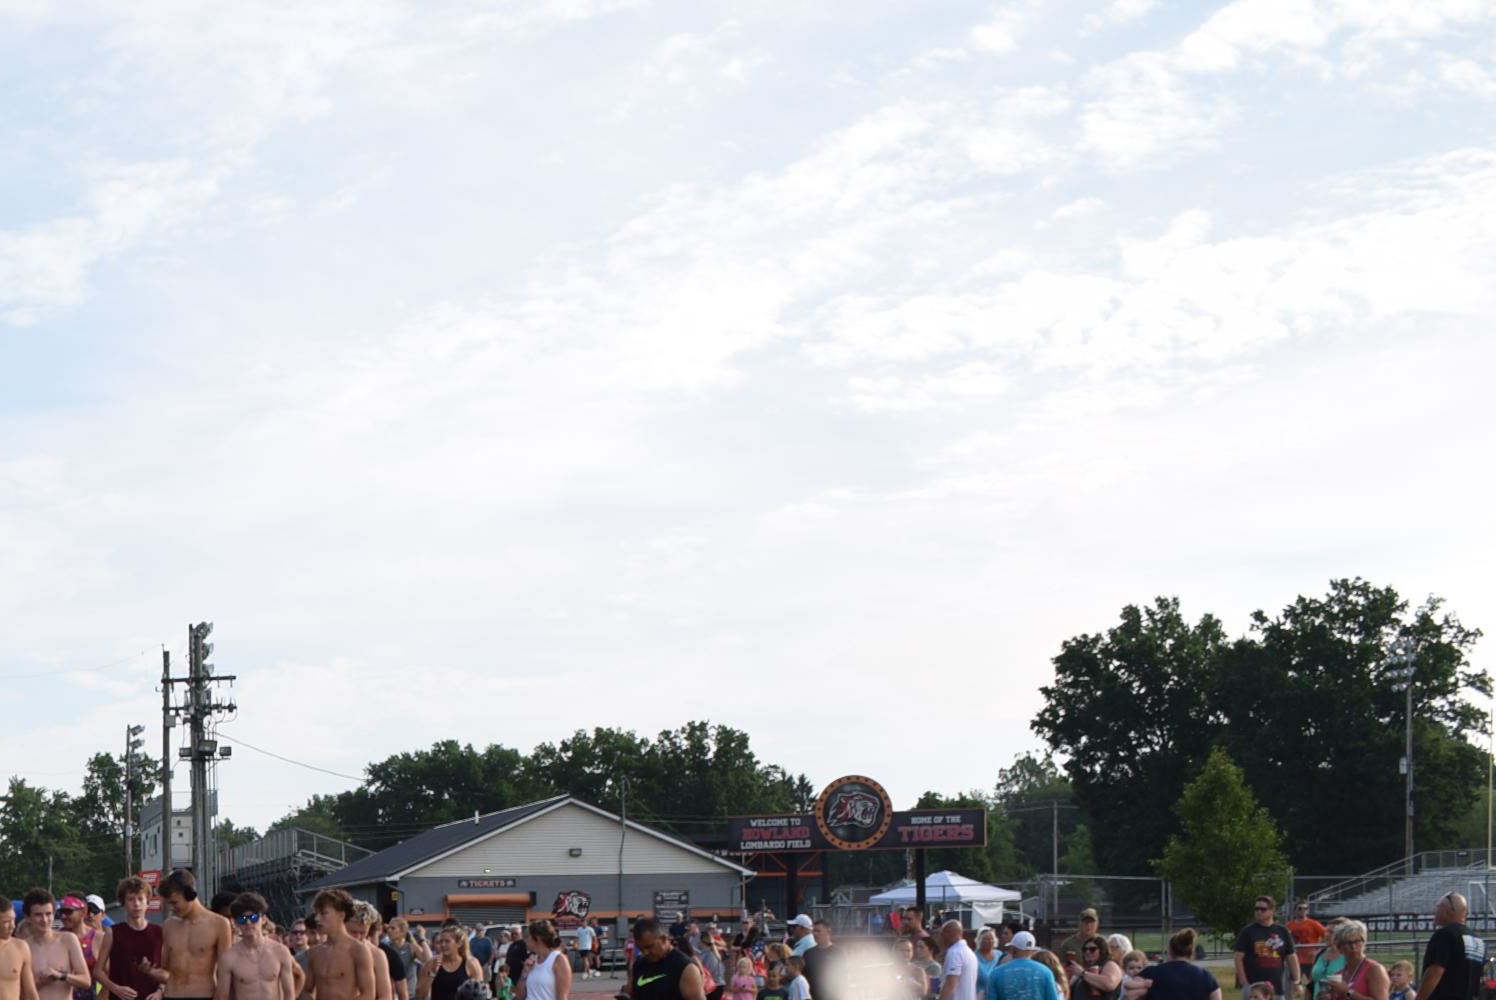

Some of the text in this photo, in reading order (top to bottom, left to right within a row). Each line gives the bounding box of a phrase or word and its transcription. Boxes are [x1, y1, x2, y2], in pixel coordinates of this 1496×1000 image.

[750, 818, 801, 827] WELCOME TO
[911, 815, 961, 824] HOME OF THE
[897, 824, 975, 842] TIGERS
[740, 840, 811, 849] LOMBARDO FIELD
[470, 880, 505, 888] TICKETS
